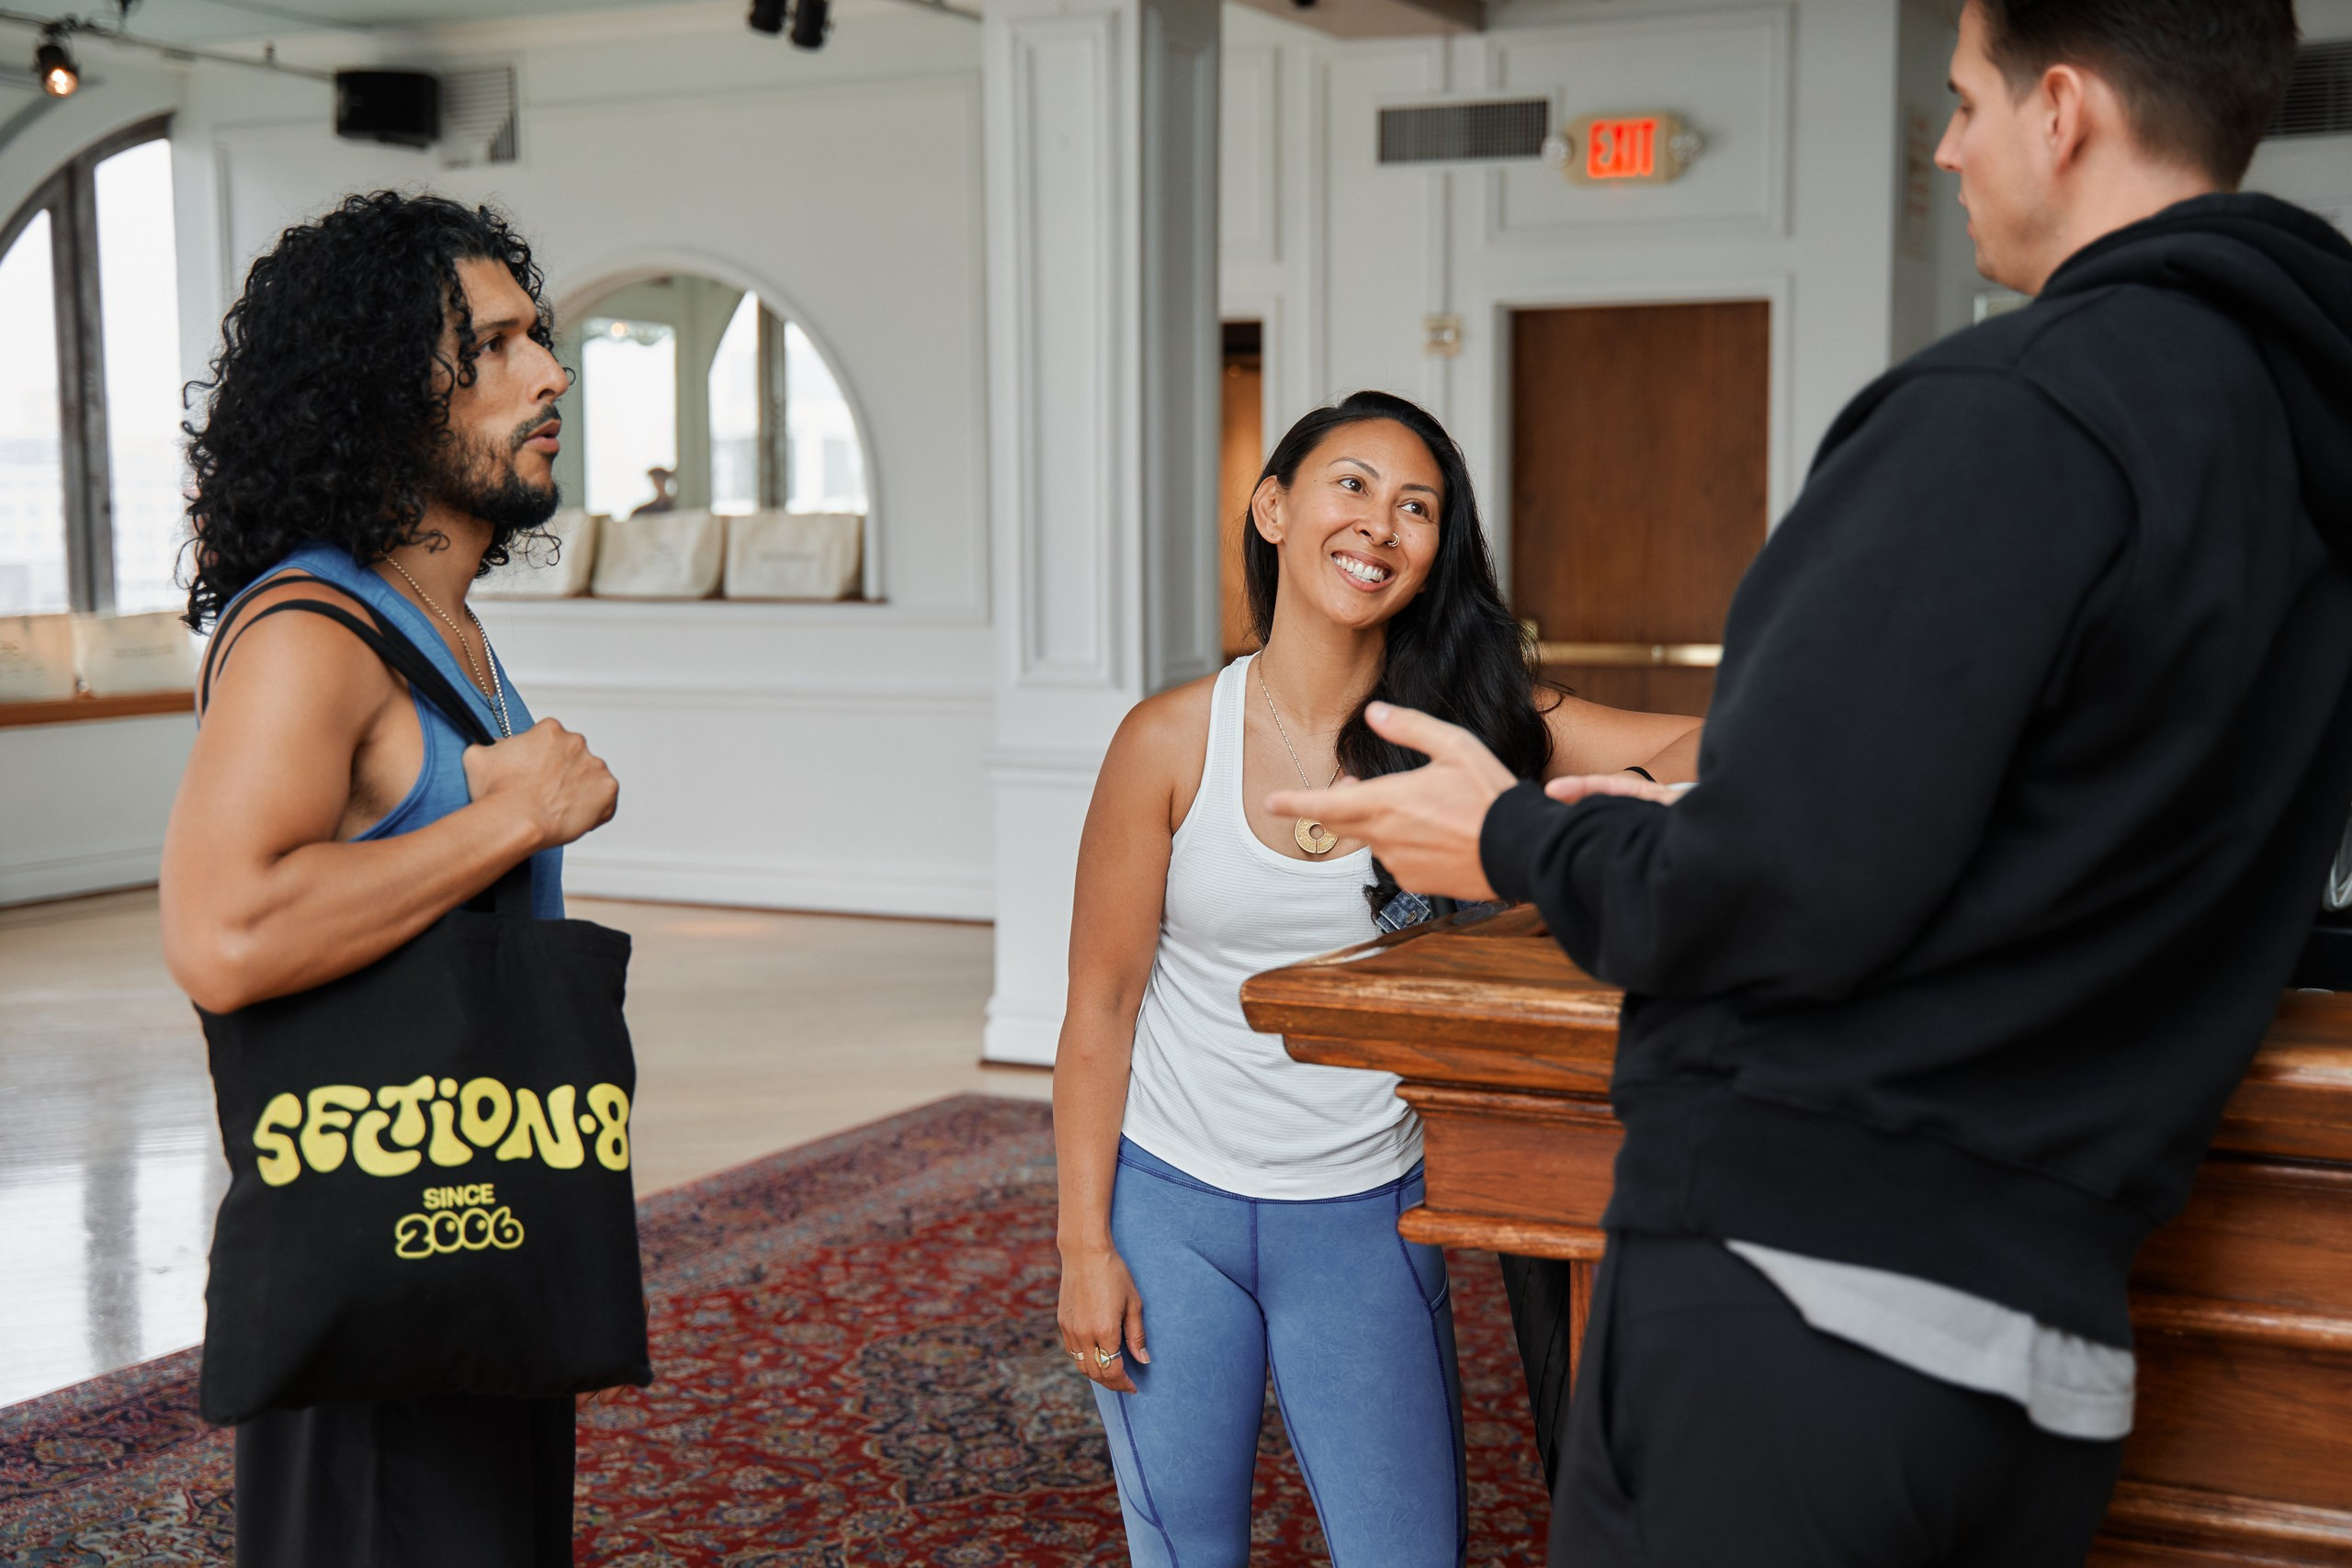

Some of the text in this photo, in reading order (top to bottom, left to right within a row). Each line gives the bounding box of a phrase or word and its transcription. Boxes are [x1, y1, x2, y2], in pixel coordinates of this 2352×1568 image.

[1587, 118, 1657, 179] EXIT
[423, 1183, 495, 1210] SINCE
[395, 1206, 524, 1259] 2006
